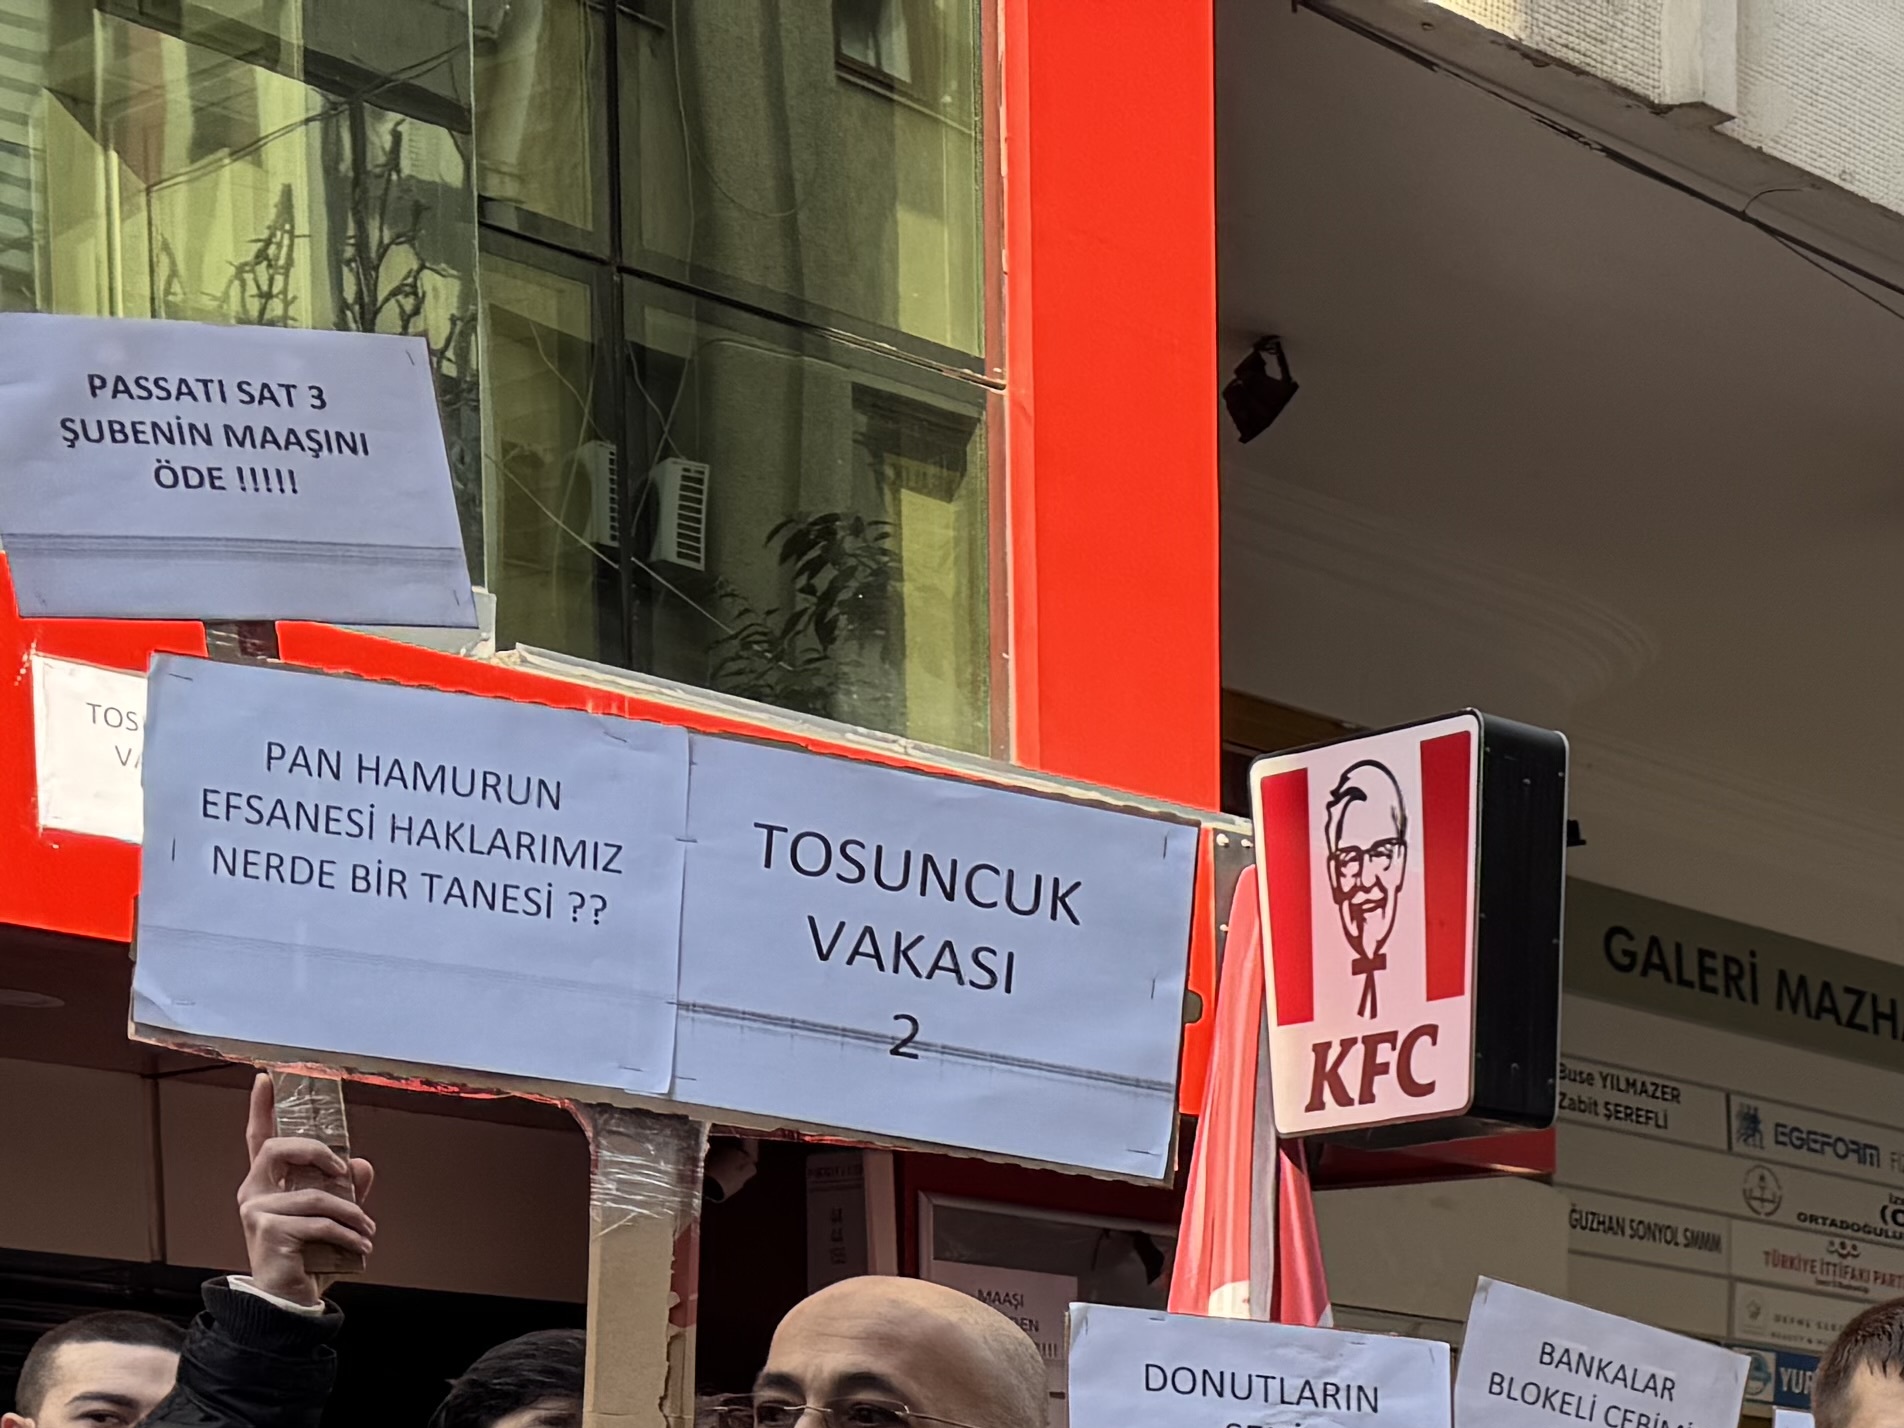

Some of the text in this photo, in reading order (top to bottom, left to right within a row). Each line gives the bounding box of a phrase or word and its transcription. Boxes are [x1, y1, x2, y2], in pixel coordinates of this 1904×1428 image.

[87, 372, 327, 411] PASSATI SAT 3
[60, 411, 371, 459] ŞUBENİN MAAŞINI
[153, 455, 228, 494] ÖDE
[265, 741, 563, 812] PAN HAMURUN
[200, 786, 624, 877] EFSANESİ HAKLARIMIZ
[211, 846, 609, 927] NERDE BİR TANESİ ??
[752, 822, 1084, 927] TOSUNCUK
[806, 915, 1017, 995] VAKASI
[1603, 925, 1760, 1005] GALERİ
[888, 1013, 922, 1060] 2
[1304, 1023, 1440, 1114] KFC
[1598, 1070, 1682, 1104] YILMAZER
[1603, 1103, 1669, 1130] ŞEREFLİ
[1774, 1121, 1881, 1169] EGEFORM
[1628, 1219, 1680, 1249] SONYOL
[1143, 1363, 1380, 1415] DONUTLARIN
[1487, 1371, 1598, 1424] BLOKELİ
[1538, 1341, 1677, 1403] BANKALAR
